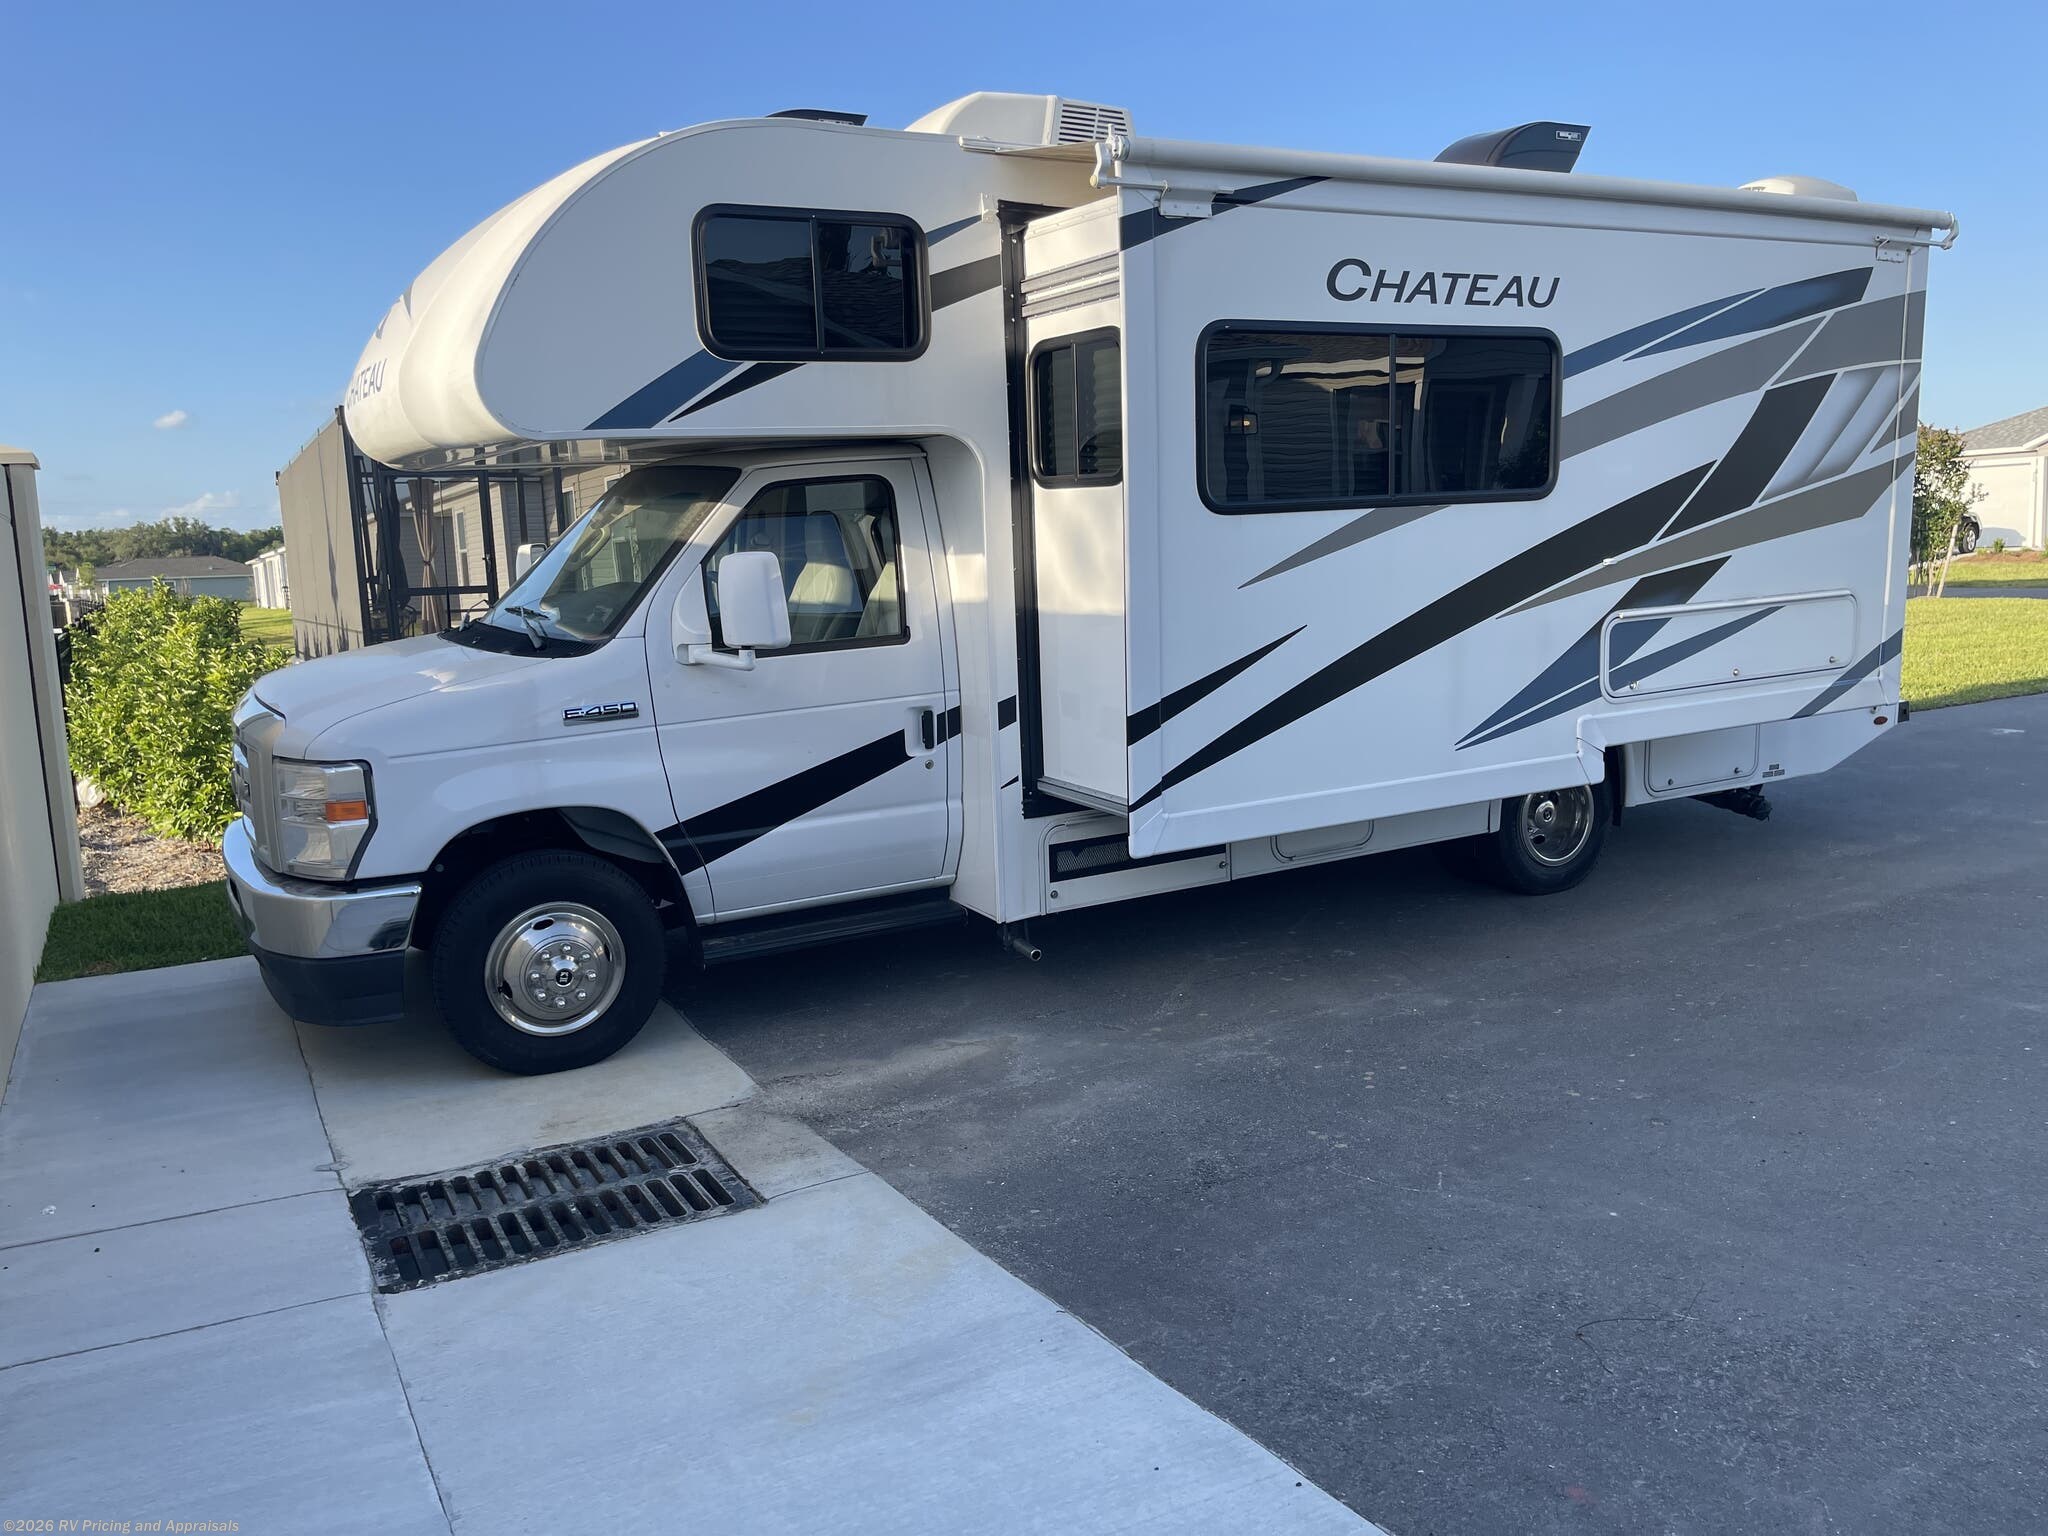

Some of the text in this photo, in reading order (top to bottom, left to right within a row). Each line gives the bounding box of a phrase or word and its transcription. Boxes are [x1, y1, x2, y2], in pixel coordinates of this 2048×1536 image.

[1326, 258, 1560, 308] CHATEAU
[346, 358, 387, 410] HATEAU
[563, 701, 639, 720] E-450
